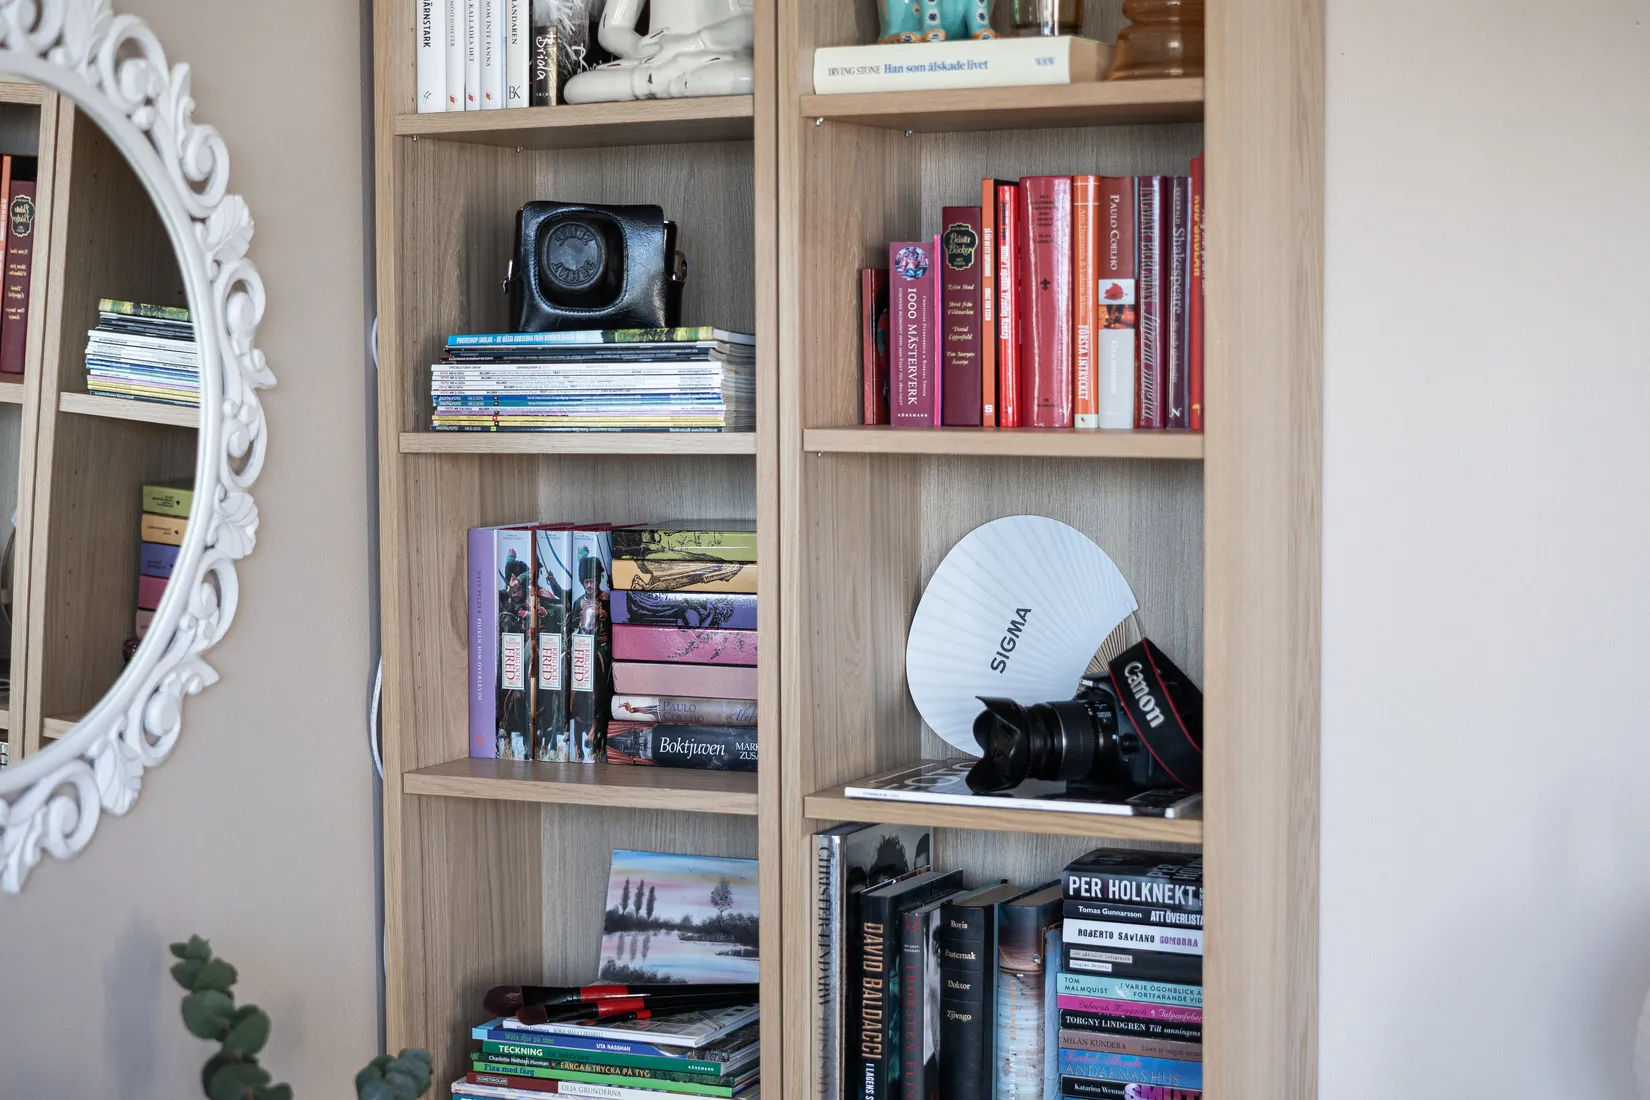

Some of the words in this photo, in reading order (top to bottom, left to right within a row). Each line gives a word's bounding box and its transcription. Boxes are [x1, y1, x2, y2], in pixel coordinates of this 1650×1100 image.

[422, 0, 434, 48] ÄRNSTARK
[536, 32, 554, 81] Brida
[884, 63, 904, 74] Han
[905, 64, 926, 73] som
[927, 61, 966, 72] älskade
[967, 59, 989, 71] livet
[827, 66, 855, 77] IRVING
[856, 65, 880, 76] STONE
[1109, 194, 1121, 228] PAULO
[1139, 184, 1158, 236] INGMAR
[1109, 230, 1121, 270] COELHO
[1139, 241, 1158, 303] BERGMAN
[1170, 228, 1185, 314] Shakespeare
[907, 288, 918, 319] 1000
[1077, 325, 1090, 354] FÖRSTA
[907, 324, 919, 406] MÄSTERVERK
[1077, 356, 1089, 401] INTRYCKET
[1140, 369, 1157, 420] magica
[990, 608, 1032, 674] SIGMA
[505, 648, 514, 681] FRED
[542, 648, 552, 681] FRED
[574, 649, 584, 682] FRED
[663, 701, 697, 712] PAULO
[1124, 661, 1165, 728] Canon
[660, 737, 726, 759] Boktjuven
[739, 751, 759, 760] ZUS
[817, 846, 833, 927] CHRISTER
[1069, 875, 1102, 898] PER
[1108, 879, 1196, 906] HOLKNEKT
[1078, 905, 1101, 914] Tomas
[1101, 908, 1142, 918] Gunnarsson
[1150, 911, 1165, 922] ATT
[950, 920, 968, 929] Boris
[863, 922, 884, 972] DAVID
[1077, 928, 1114, 940] ROBERTO
[1118, 931, 1155, 943] SAVIANO
[1159, 935, 1199, 948] GOMORRA
[945, 948, 977, 960] Pasternak
[818, 933, 832, 1006] LINDARW
[947, 979, 971, 990] Doktor
[1064, 984, 1108, 995] MALMQUIST
[1125, 983, 1147, 991] VARJE
[906, 964, 917, 1050] THORSTEN
[1077, 999, 1110, 1011] Deborah
[1133, 990, 1187, 1003] FORTFARANDE
[1189, 996, 1203, 1004] VID
[862, 977, 883, 1059] BALDACCI
[946, 1010, 972, 1022] Zjivago
[1065, 1015, 1100, 1026] TORGNY
[1102, 1019, 1146, 1031] LINDGREN
[1149, 1024, 1162, 1033] Till
[1163, 1027, 1202, 1039] sanningens
[498, 1045, 543, 1056] TECKNING
[505, 1033, 519, 1041] Måla
[520, 1034, 532, 1043] djur
[533, 1036, 541, 1044] på
[1062, 1037, 1089, 1046] MILAN
[1090, 1039, 1127, 1050] KUNDERA
[1141, 1044, 1157, 1053] Livet
[484, 1063, 501, 1072] Fixa
[501, 1065, 519, 1073] med
[519, 1067, 535, 1077] färg
[560, 1061, 585, 1071] FÄRGA
[591, 1064, 620, 1076] TRYCKA
[622, 1067, 633, 1076] PÅ
[635, 1069, 650, 1078] TYG
[865, 1067, 876, 1094] LAGENS
[1065, 1063, 1146, 1082] ANDARNAS
[1150, 1073, 1180, 1086] HUS
[561, 1084, 578, 1092] OLJA
[578, 1086, 622, 1097] GRUNDERNA
[1074, 1083, 1101, 1093] Katarina
